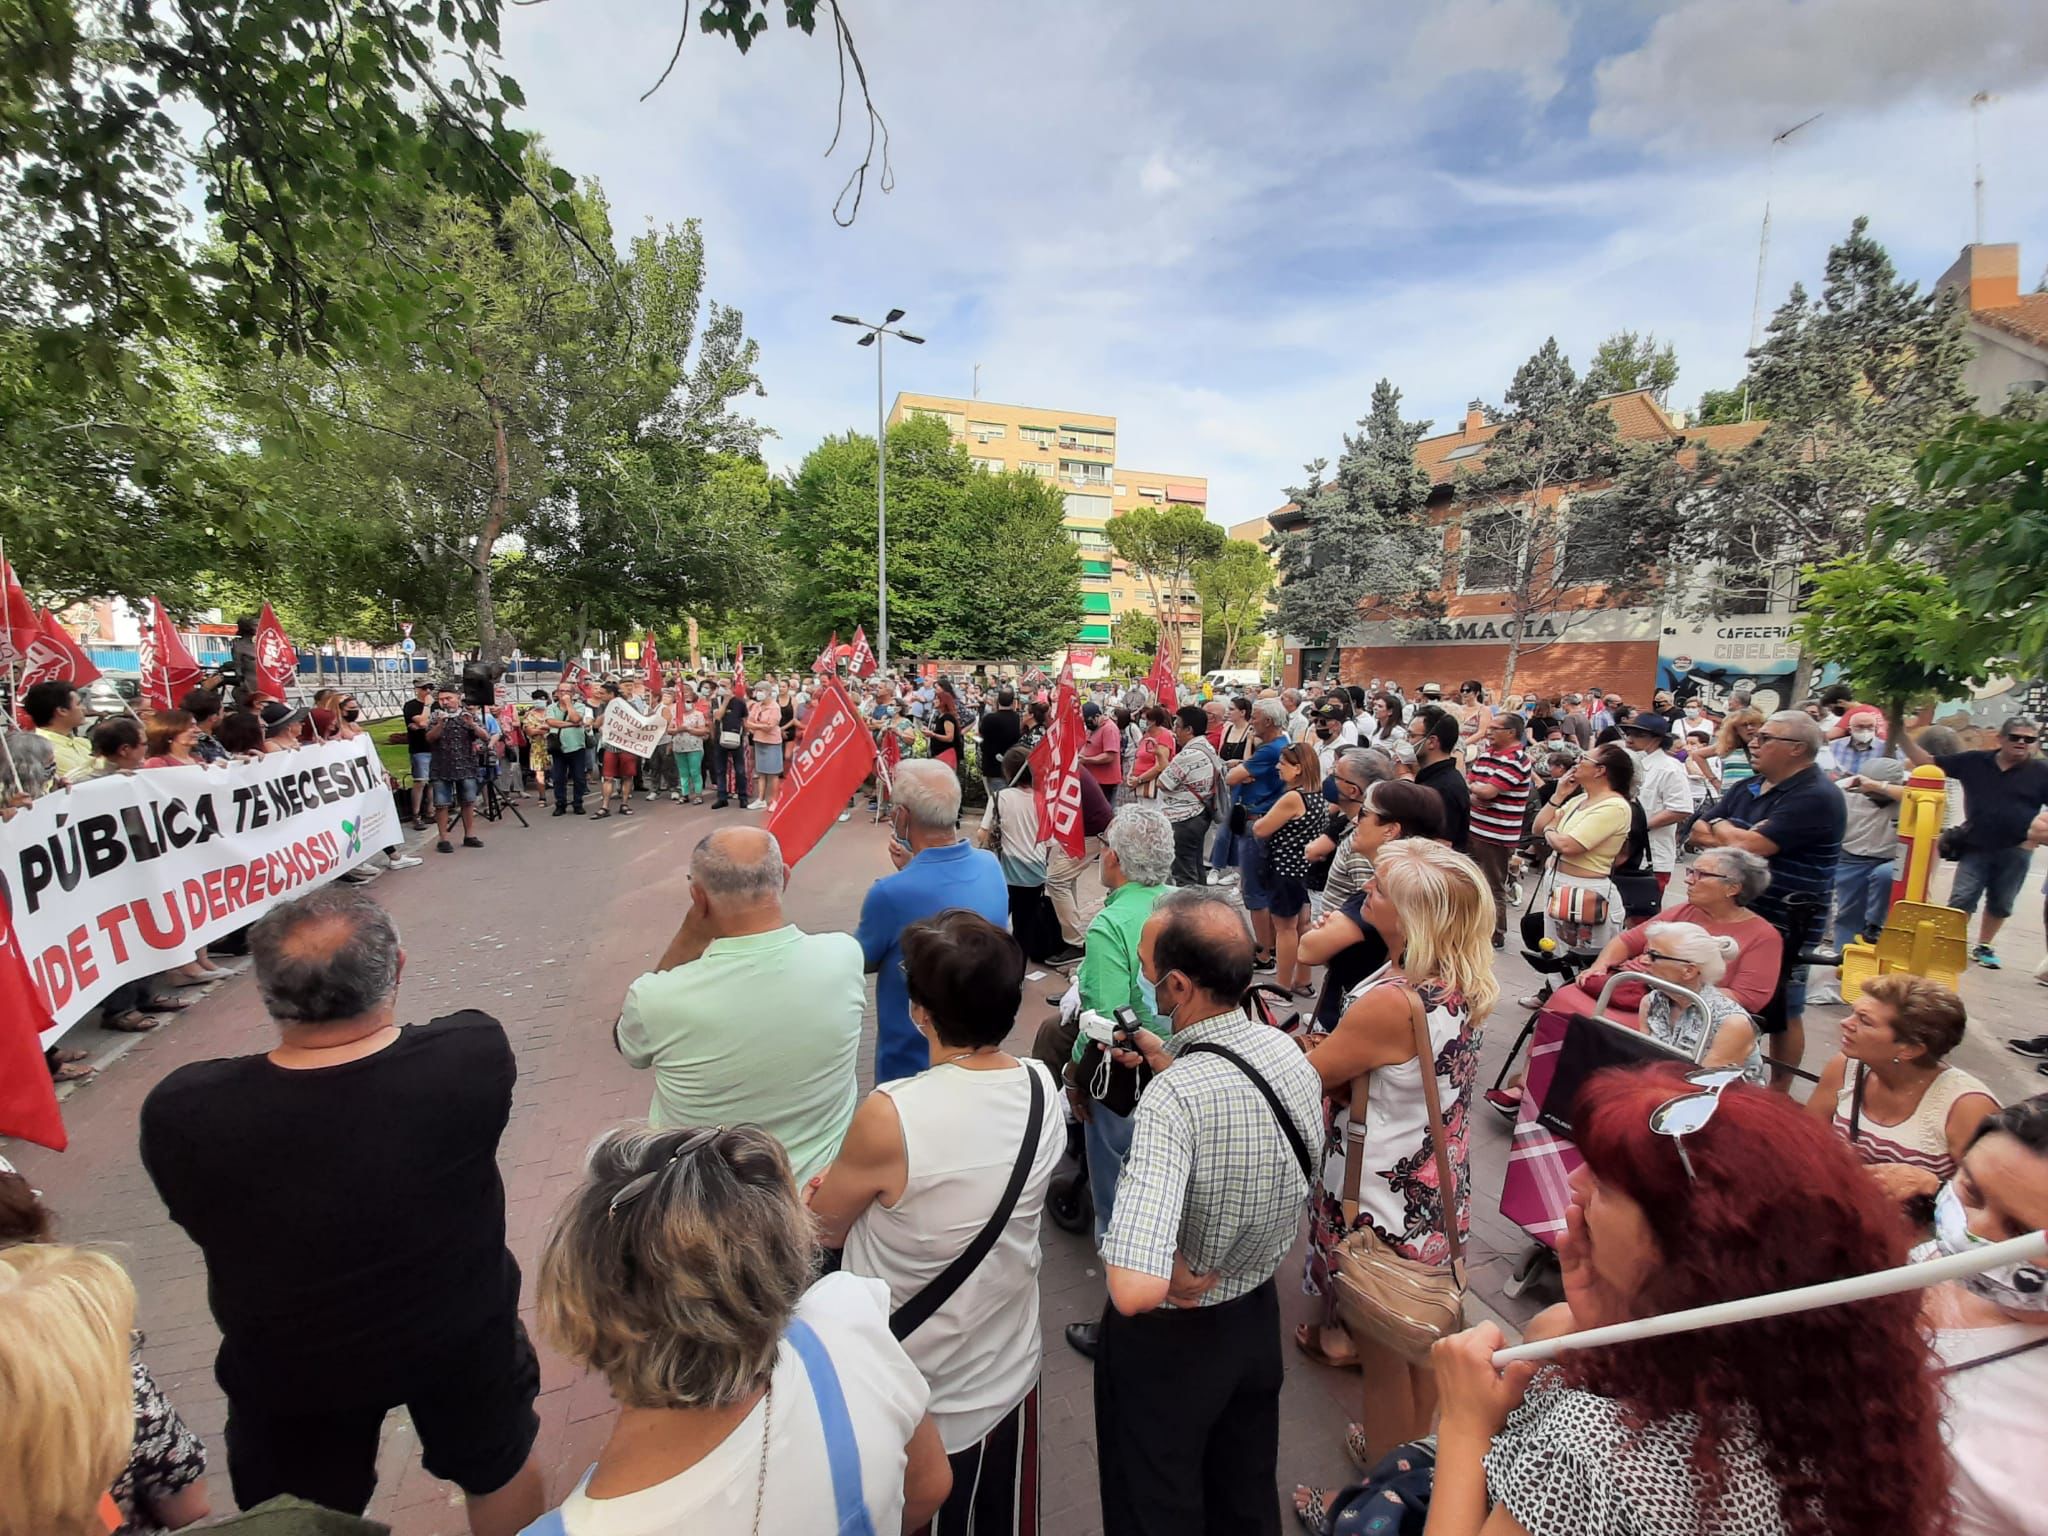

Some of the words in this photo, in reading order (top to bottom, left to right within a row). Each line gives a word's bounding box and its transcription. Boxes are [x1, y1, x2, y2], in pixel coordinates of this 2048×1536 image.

[1714, 643, 1800, 660] CIBELES
[607, 717, 624, 732] 100
[636, 732, 655, 743] 100
[612, 706, 658, 731] SANIDAD
[19, 793, 224, 915] PÚBLICA
[233, 784, 271, 833] TE
[96, 889, 187, 965] TU
[182, 830, 340, 931] DERECHOS!!
